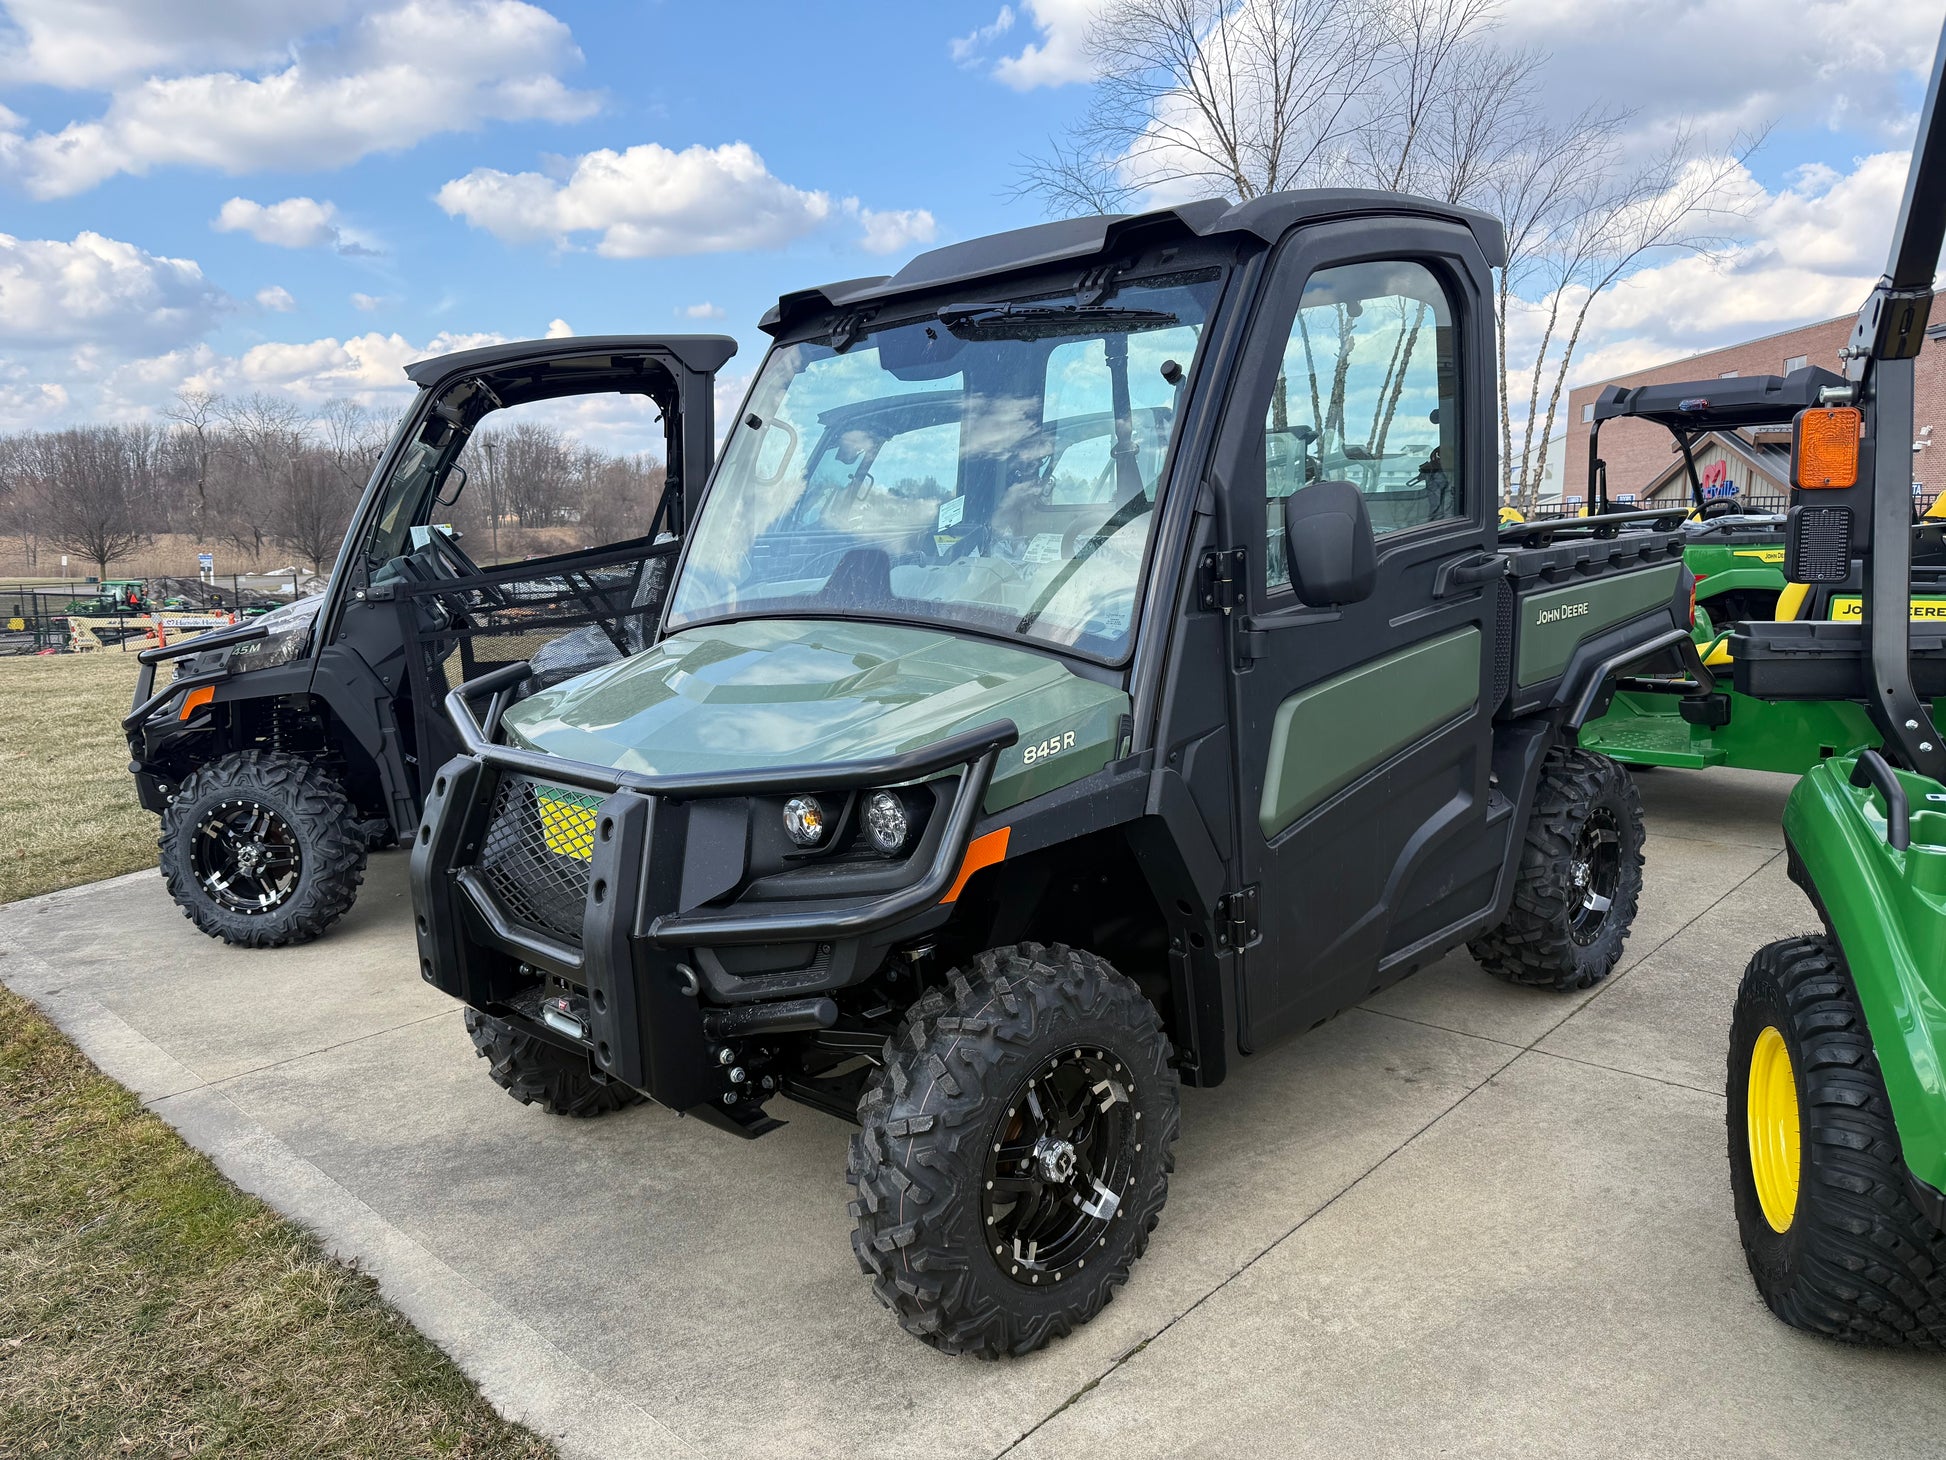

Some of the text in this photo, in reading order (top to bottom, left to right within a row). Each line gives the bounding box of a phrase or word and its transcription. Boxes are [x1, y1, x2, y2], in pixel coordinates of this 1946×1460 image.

[1536, 602, 1589, 625] JOHN DEERE
[1842, 604, 1946, 617] JO ERE
[231, 642, 262, 656] 45M
